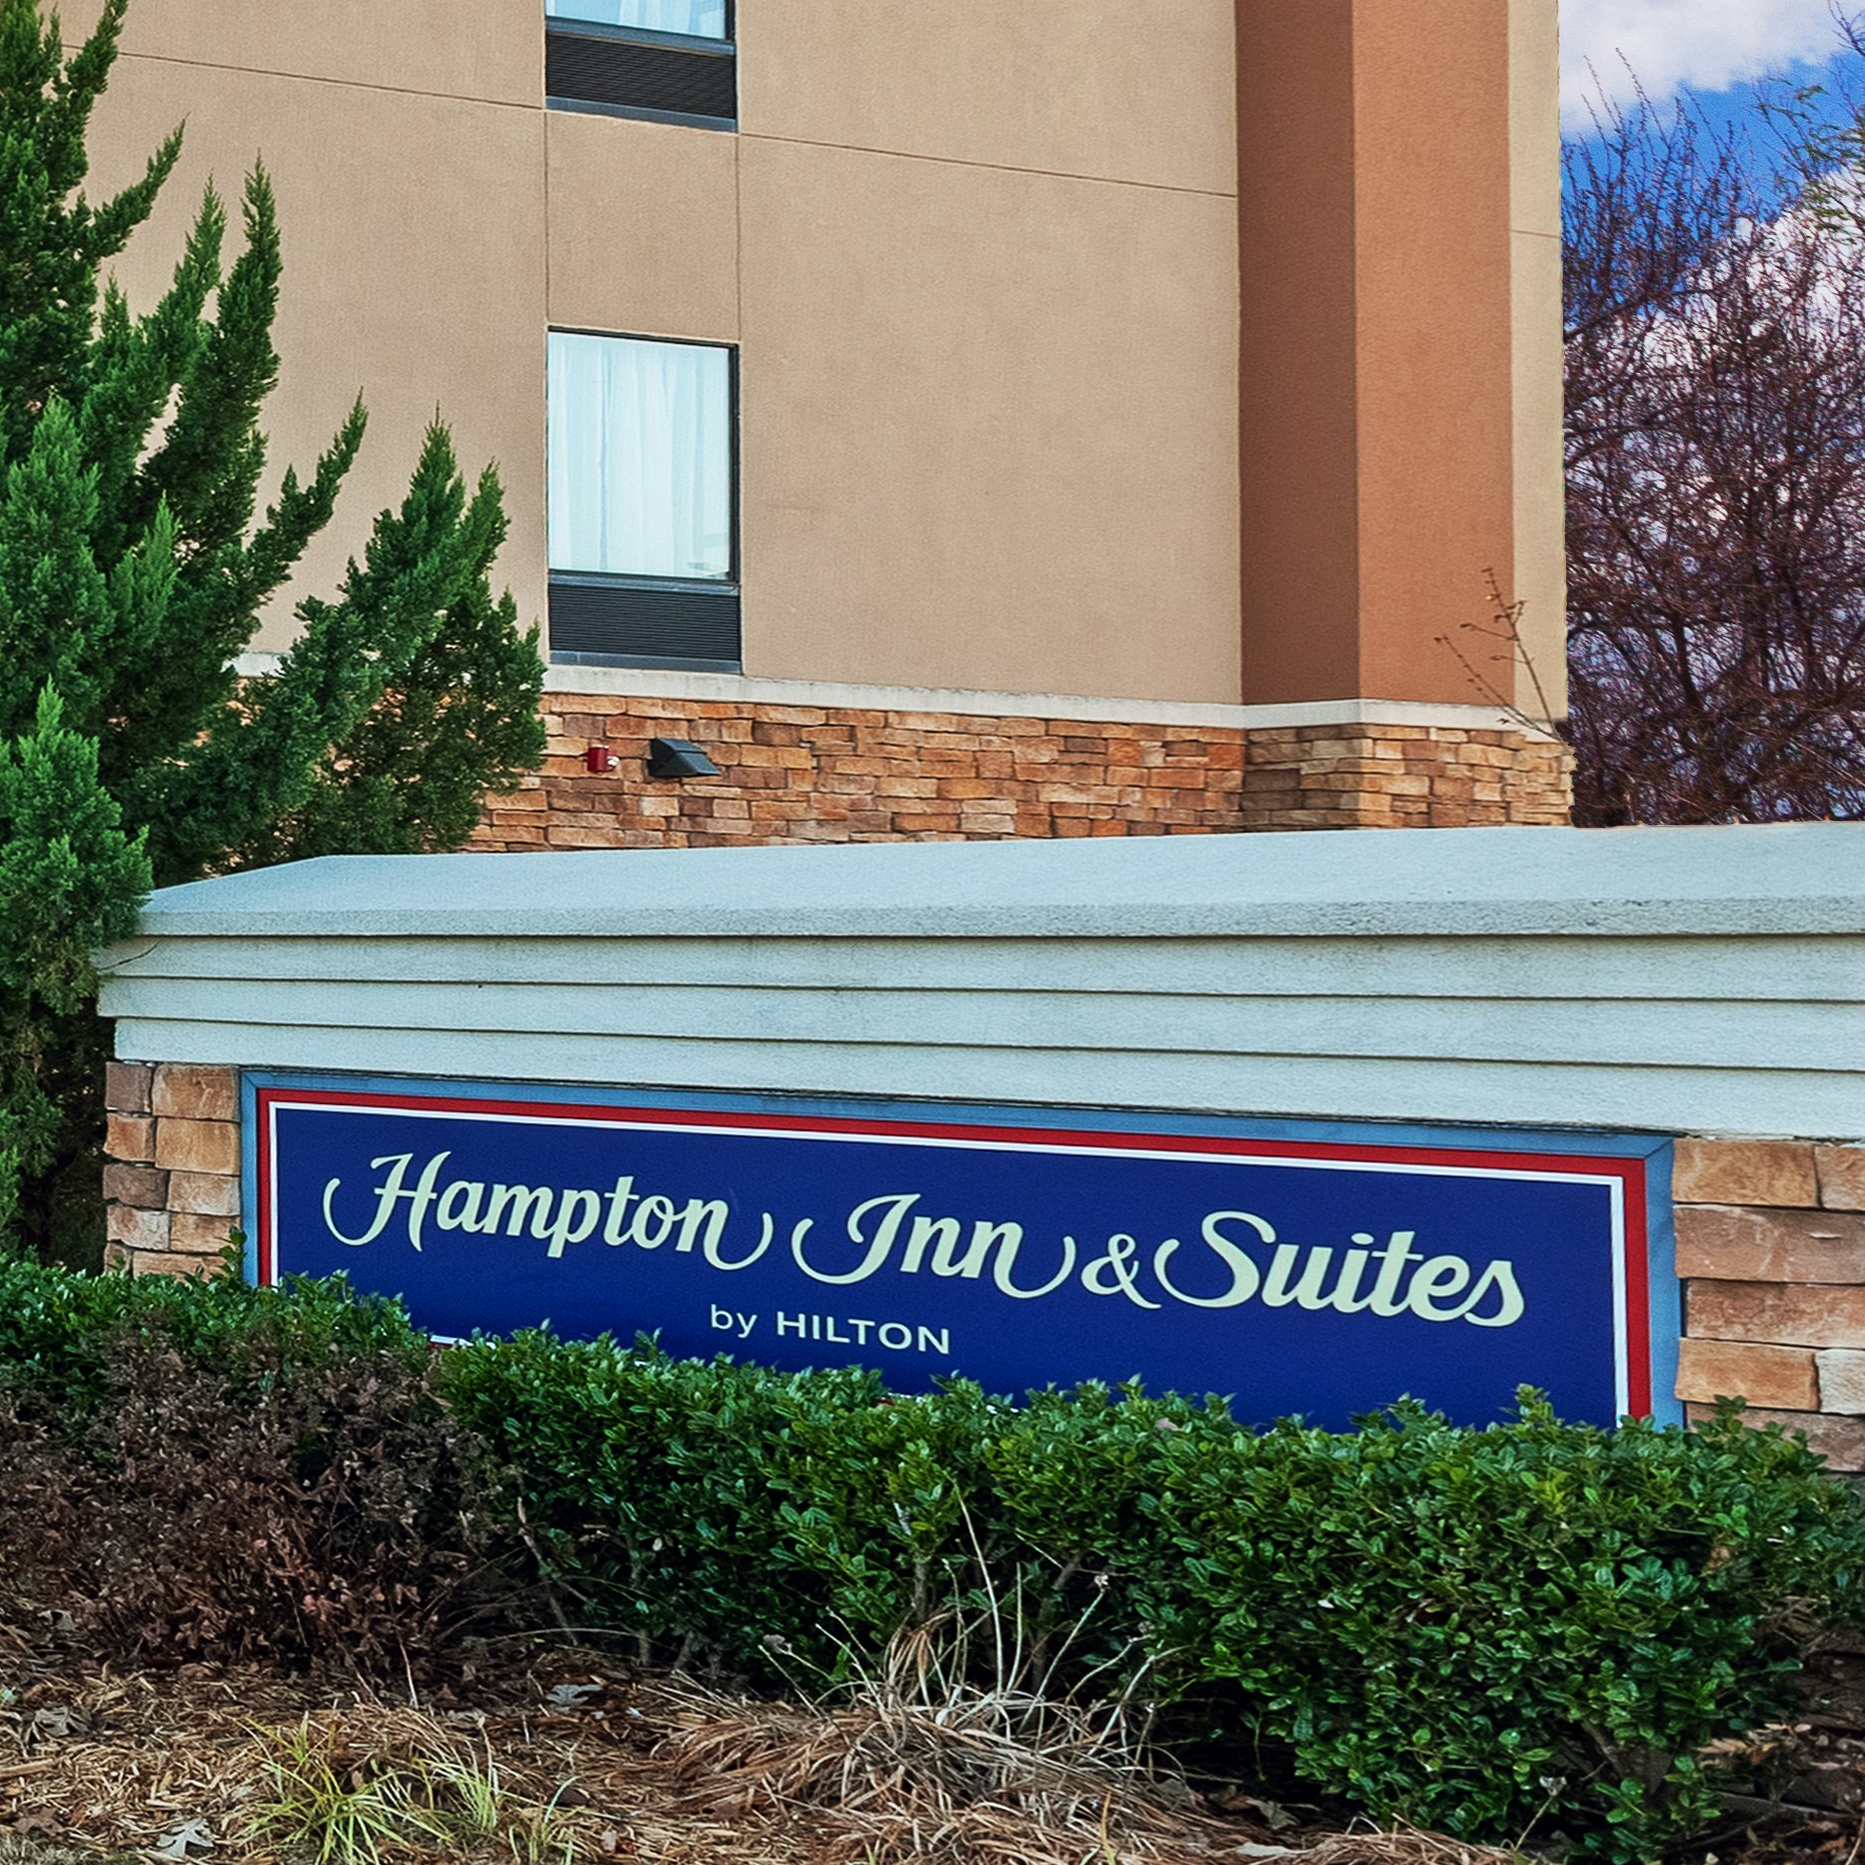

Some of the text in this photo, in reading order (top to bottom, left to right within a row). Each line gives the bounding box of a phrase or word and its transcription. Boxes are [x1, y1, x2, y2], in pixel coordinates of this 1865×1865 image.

[321, 1150, 774, 1272] Hampton
[790, 1191, 1077, 1300] Inn
[1153, 1209, 1526, 1328] Suites
[709, 1302, 951, 1356] by HILTON
